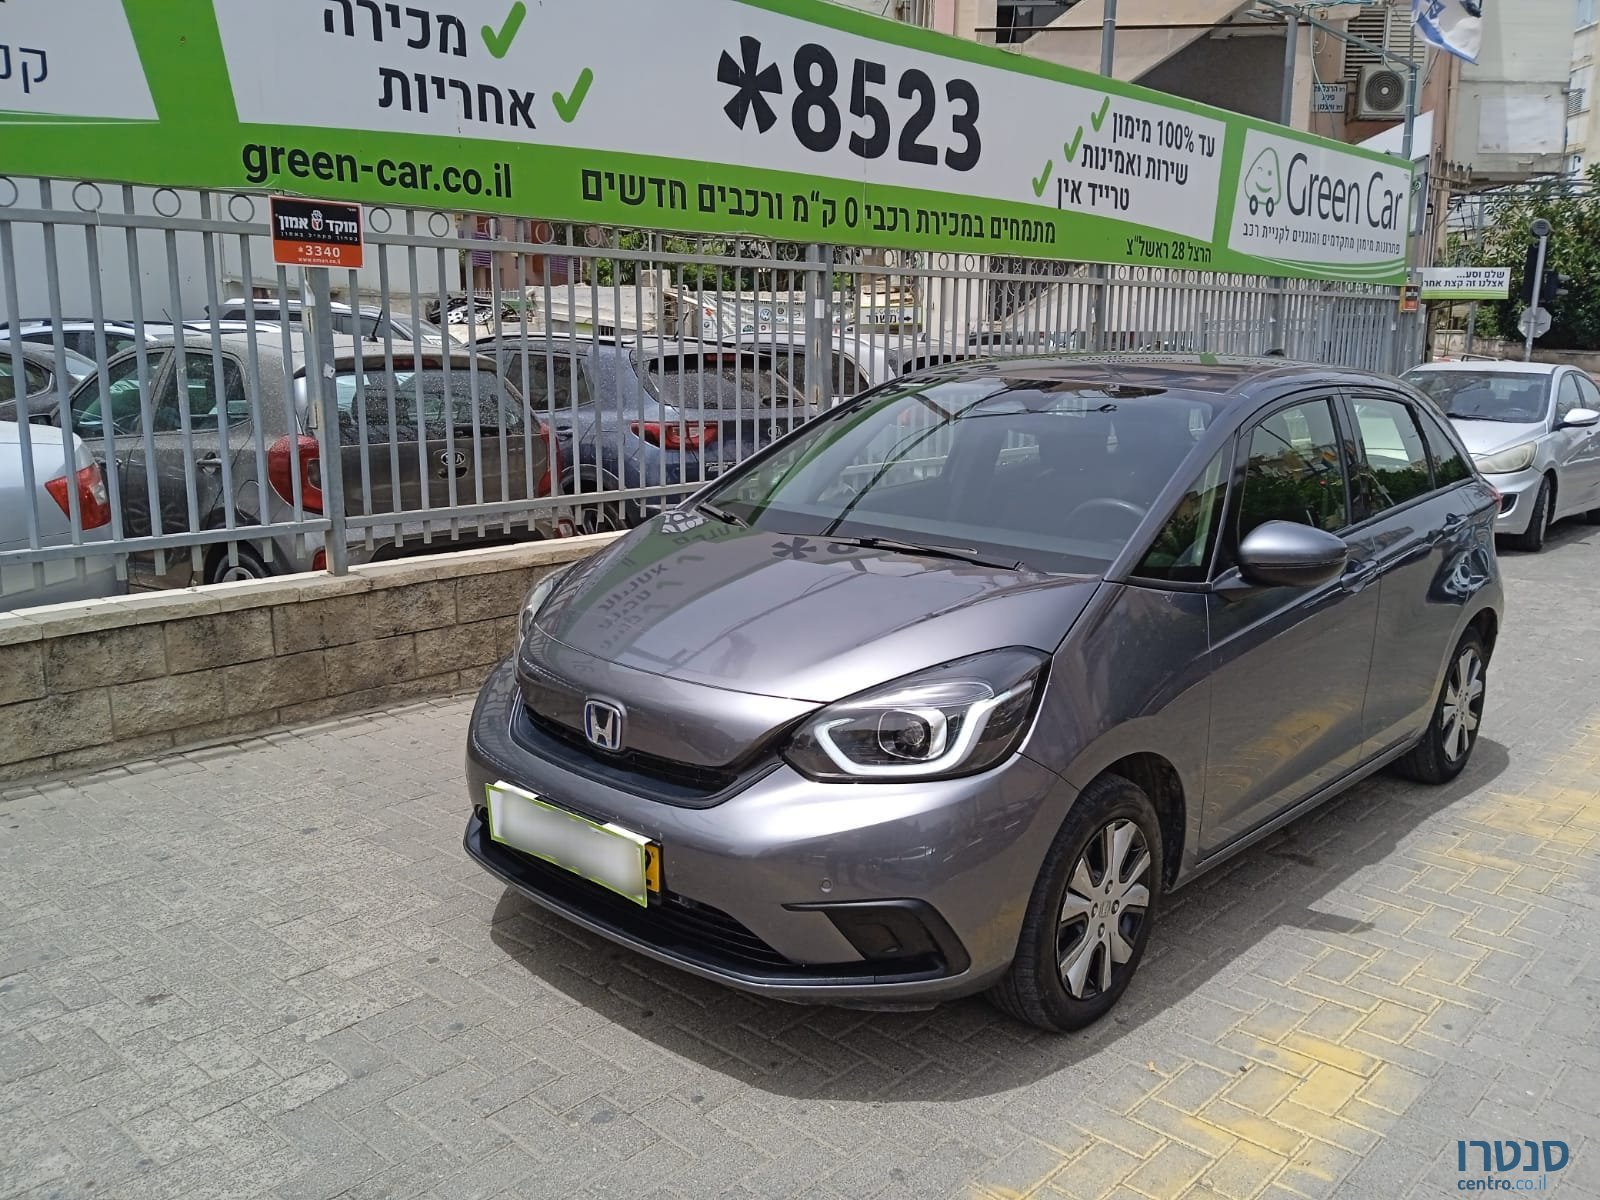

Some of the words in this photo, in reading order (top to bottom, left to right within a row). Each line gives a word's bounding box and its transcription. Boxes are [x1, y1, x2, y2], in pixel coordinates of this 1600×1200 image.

[323, 0, 468, 58] מכירה
[378, 66, 537, 130] אחריות
[1112, 112, 1152, 144] מימון
[1157, 120, 1195, 154] 100%
[1199, 133, 1215, 158] עד
[242, 143, 512, 199] green-car.co.il
[1082, 143, 1142, 177] ואמינות
[1145, 156, 1188, 186] שירות
[581, 168, 687, 210] חדשים
[698, 183, 783, 220] ורכבים
[1057, 177, 1083, 210] אין
[1088, 182, 1130, 211] טרייד
[1286, 152, 1360, 225] Green
[1366, 171, 1403, 231] Car
[279, 215, 309, 231] אמון
[325, 219, 358, 234] מוקד
[864, 204, 910, 234] רכבי
[915, 209, 985, 238] במכירת
[990, 216, 1056, 244] מתמחים
[1242, 222, 1259, 237] רכב
[1261, 225, 1290, 244] לקניית
[1292, 229, 1320, 245] והוגנים
[1322, 232, 1354, 251] מתקדמים
[1356, 237, 1374, 253] מימון
[1171, 240, 1185, 260] 28
[1187, 245, 1212, 263] הרצל
[1444, 280, 1464, 289] קצת
[1479, 279, 1504, 287] אצלנו
[1484, 269, 1505, 279] שלם
